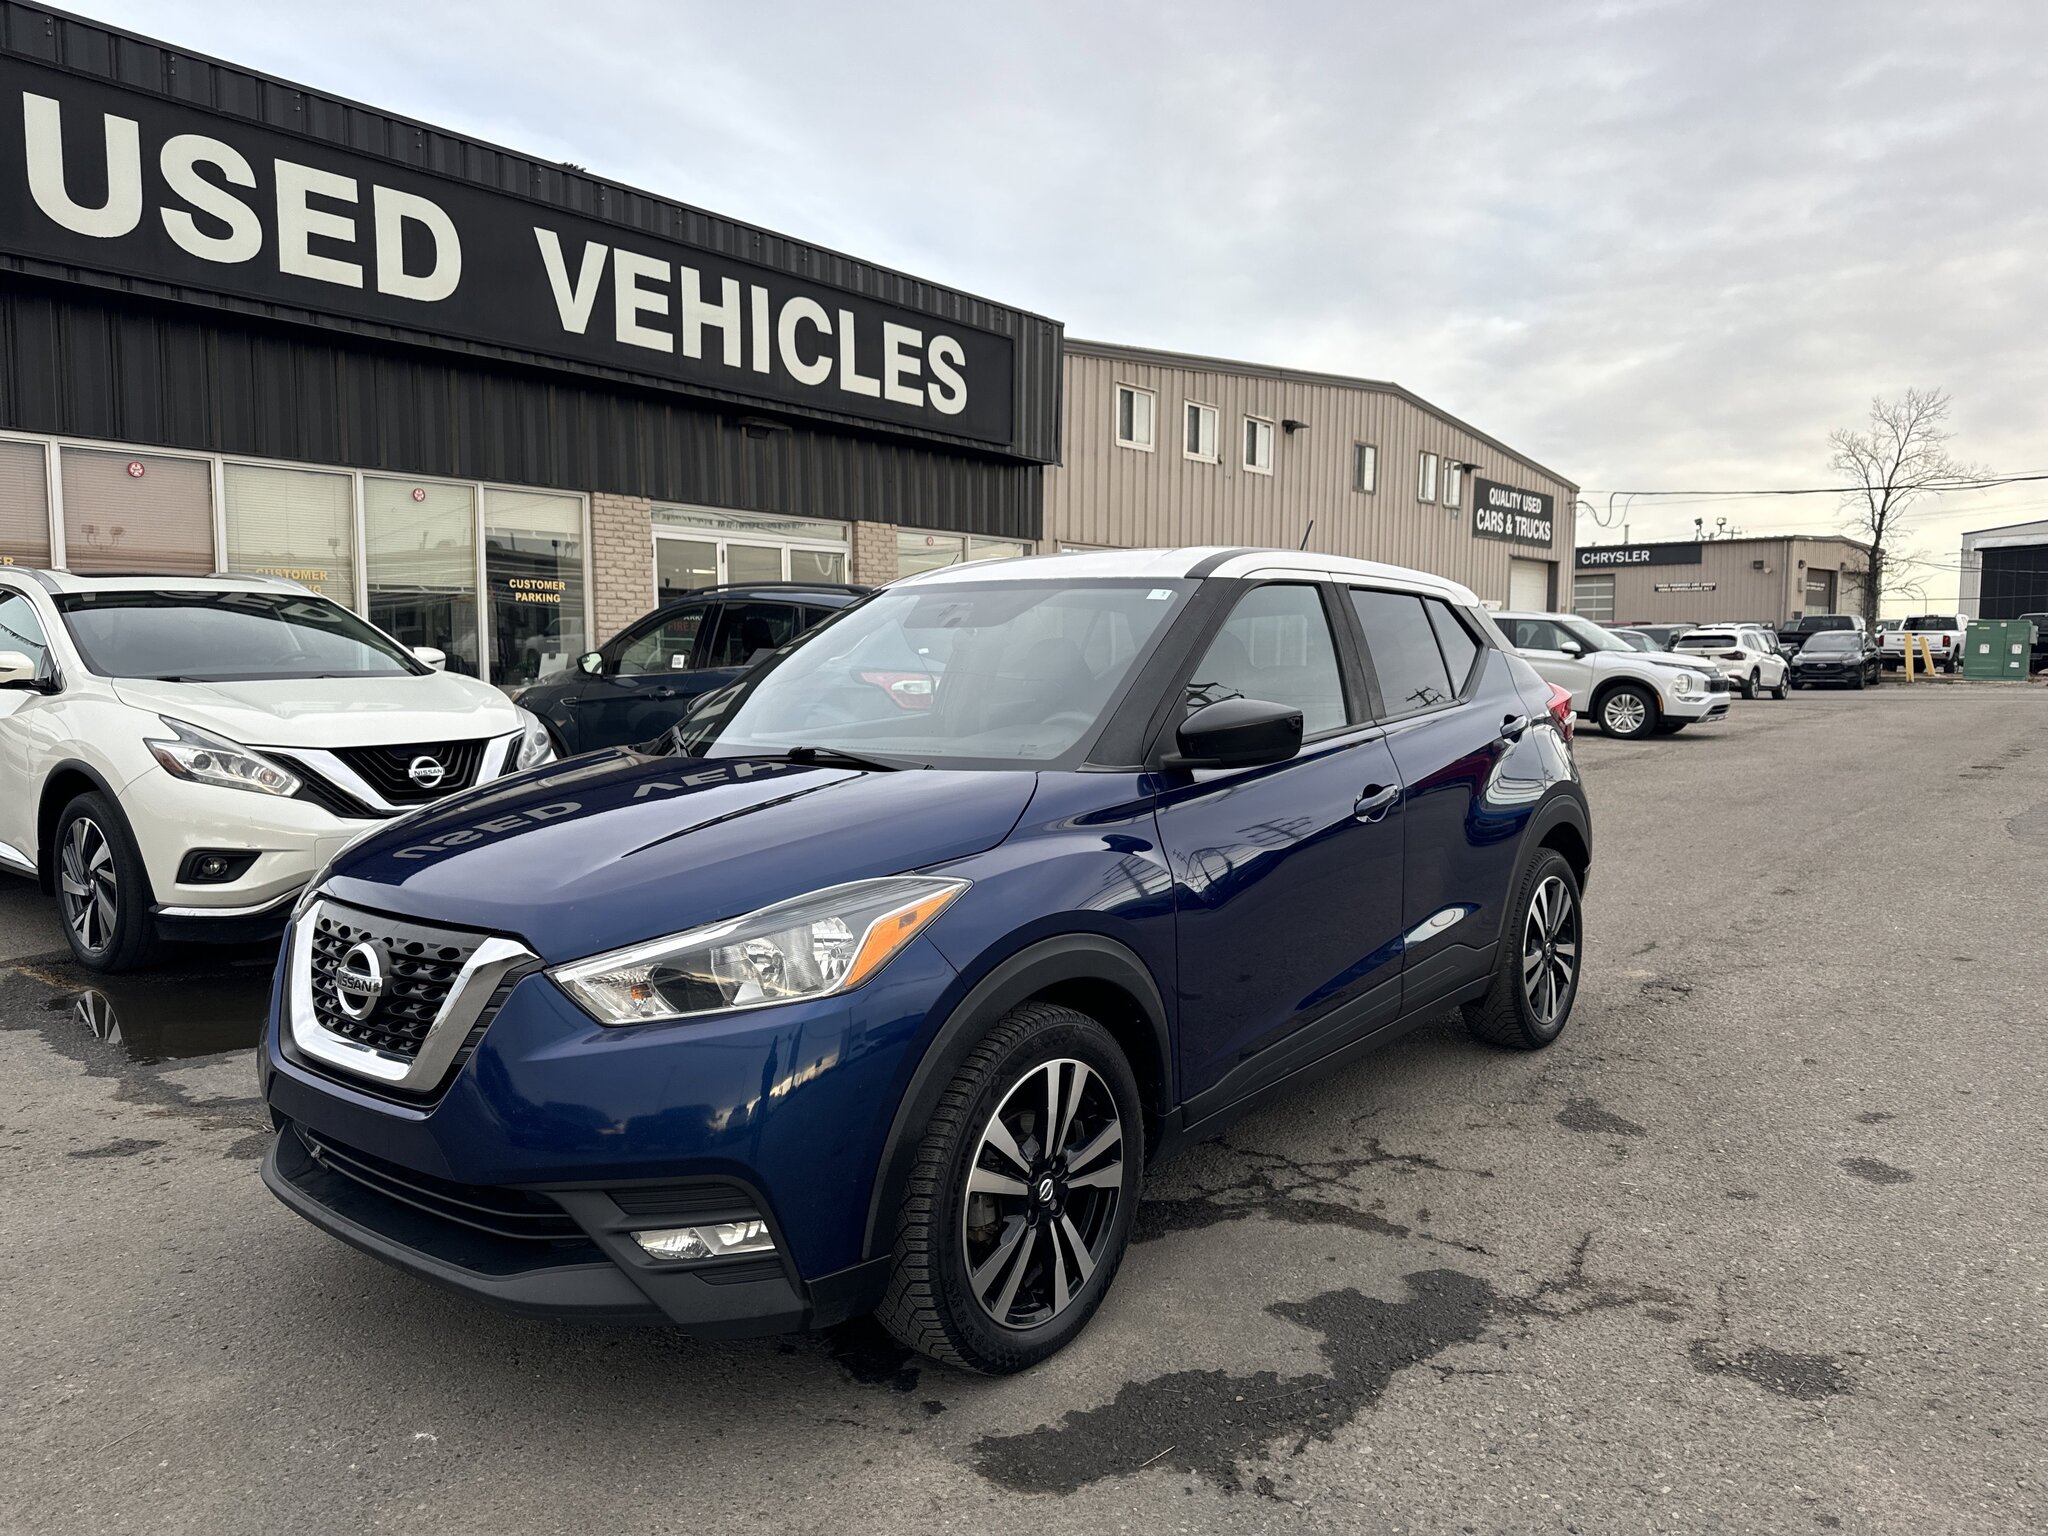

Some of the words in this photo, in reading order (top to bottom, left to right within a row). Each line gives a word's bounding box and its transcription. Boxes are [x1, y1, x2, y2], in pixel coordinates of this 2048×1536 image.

[22, 91, 462, 302] USED
[533, 226, 968, 416] VEHICLES
[1489, 487, 1522, 510] QUALITY
[1522, 494, 1542, 514] USED
[1476, 508, 1504, 531] CARS
[1505, 516, 1513, 535] &
[1515, 516, 1551, 541] TRUCKS
[1581, 550, 1650, 565] CHRYSLER
[509, 578, 566, 591] CUSTOMER
[515, 592, 561, 603] PARKING
